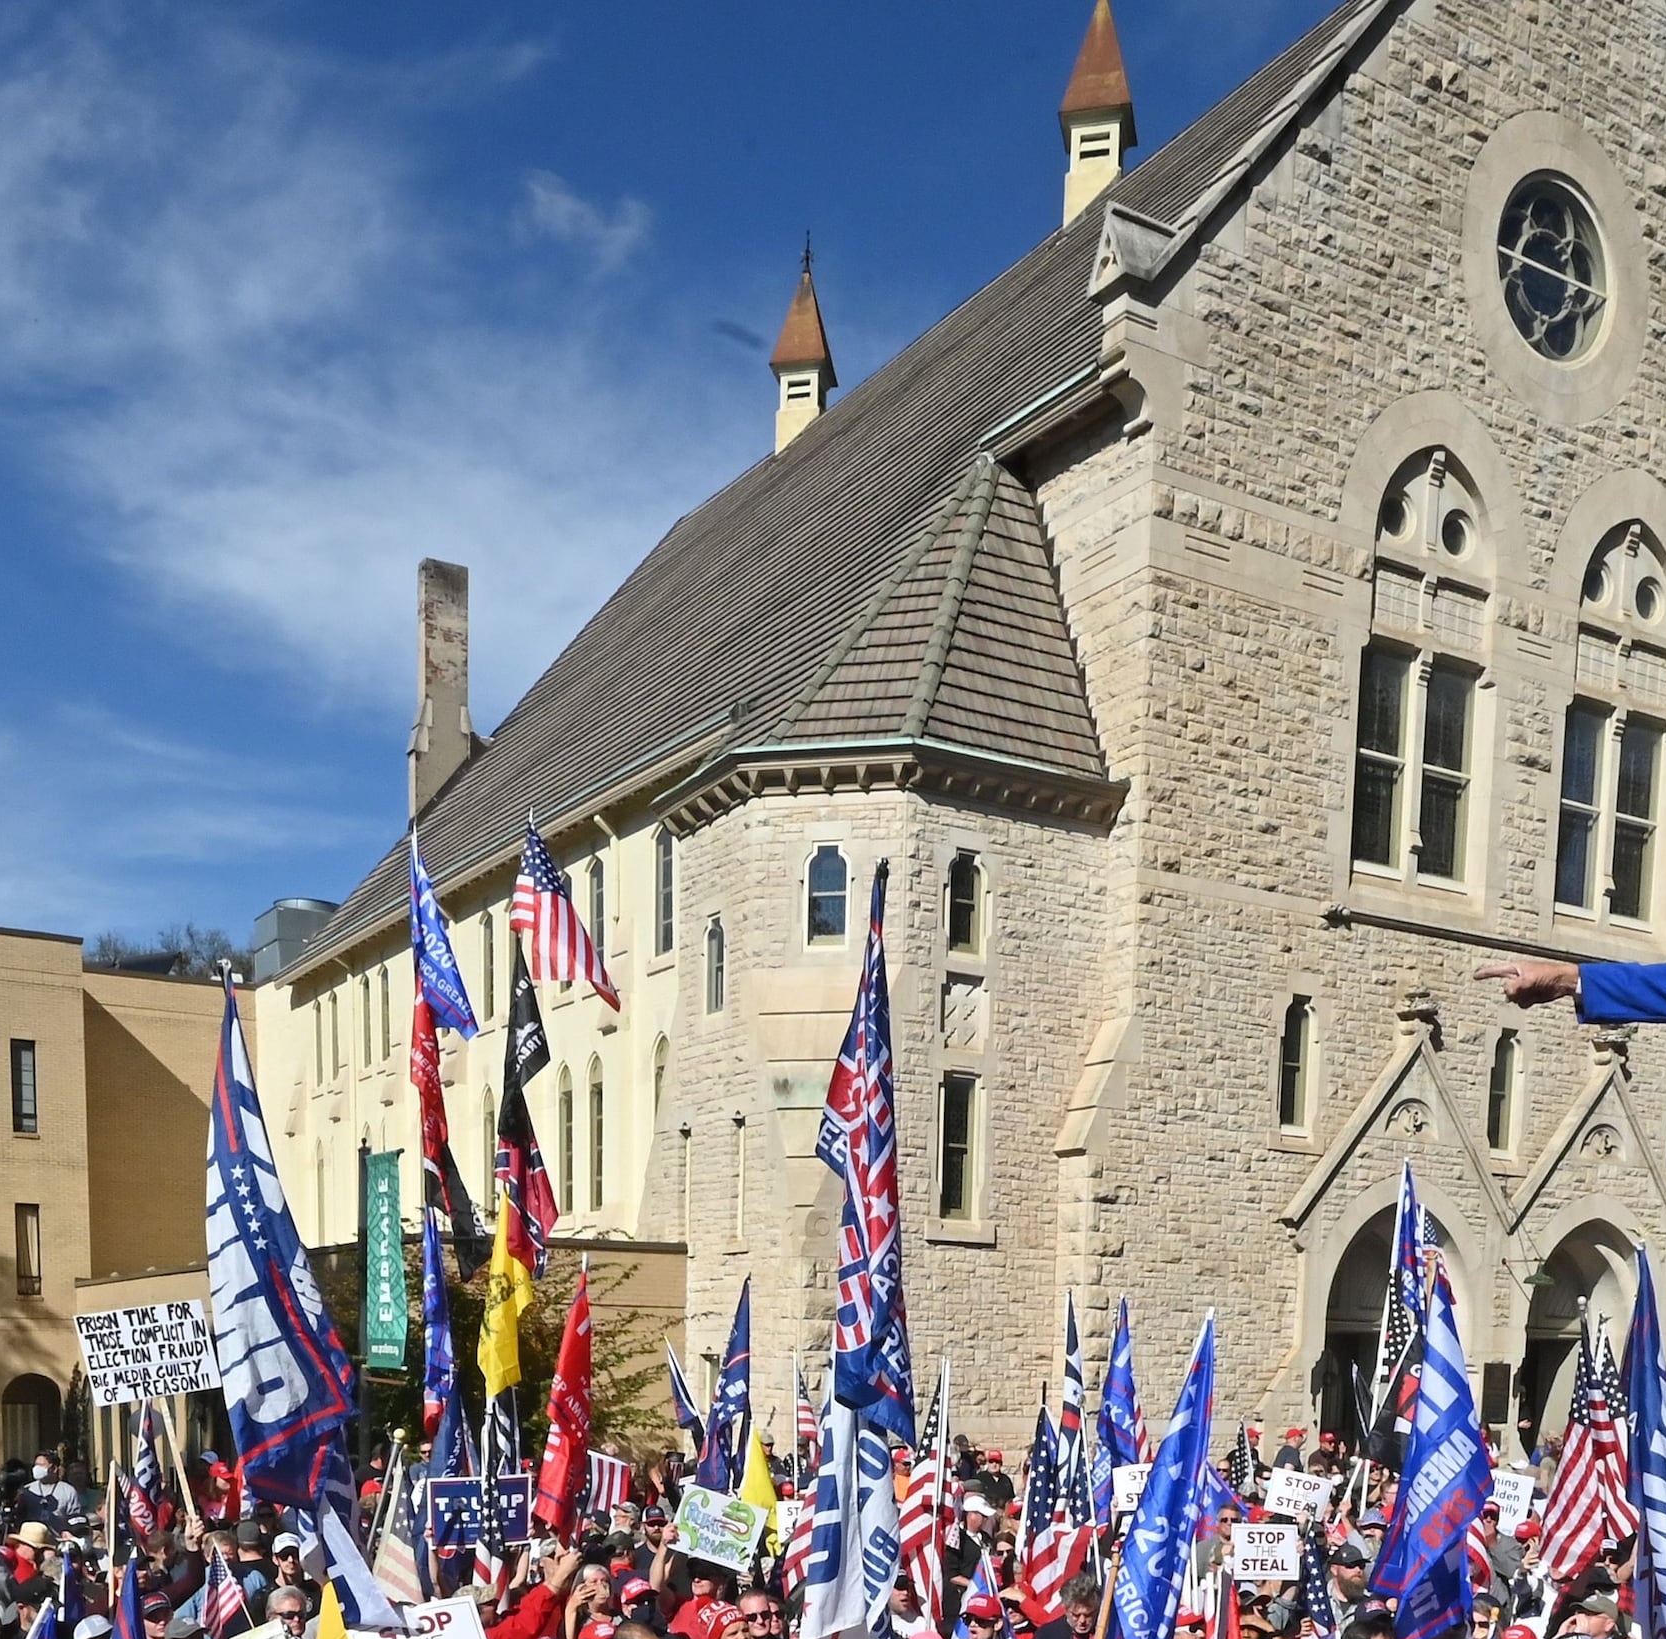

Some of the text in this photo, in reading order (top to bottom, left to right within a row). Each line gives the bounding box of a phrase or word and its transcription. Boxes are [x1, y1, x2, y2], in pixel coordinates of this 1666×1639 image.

[75, 1302, 194, 1335] PRISON TIME FOR
[84, 1319, 206, 1353] THOSE COMPLICIT IN
[87, 1346, 150, 1371] ELECTION
[91, 1358, 201, 1390] BIG MEDIA GUILTY
[104, 1372, 210, 1403] OF TREASON!!
[1284, 1476, 1321, 1494] STOP
[1246, 1531, 1286, 1545] STOP
[1253, 1545, 1278, 1558] THE
[1240, 1558, 1290, 1572] STEAL
